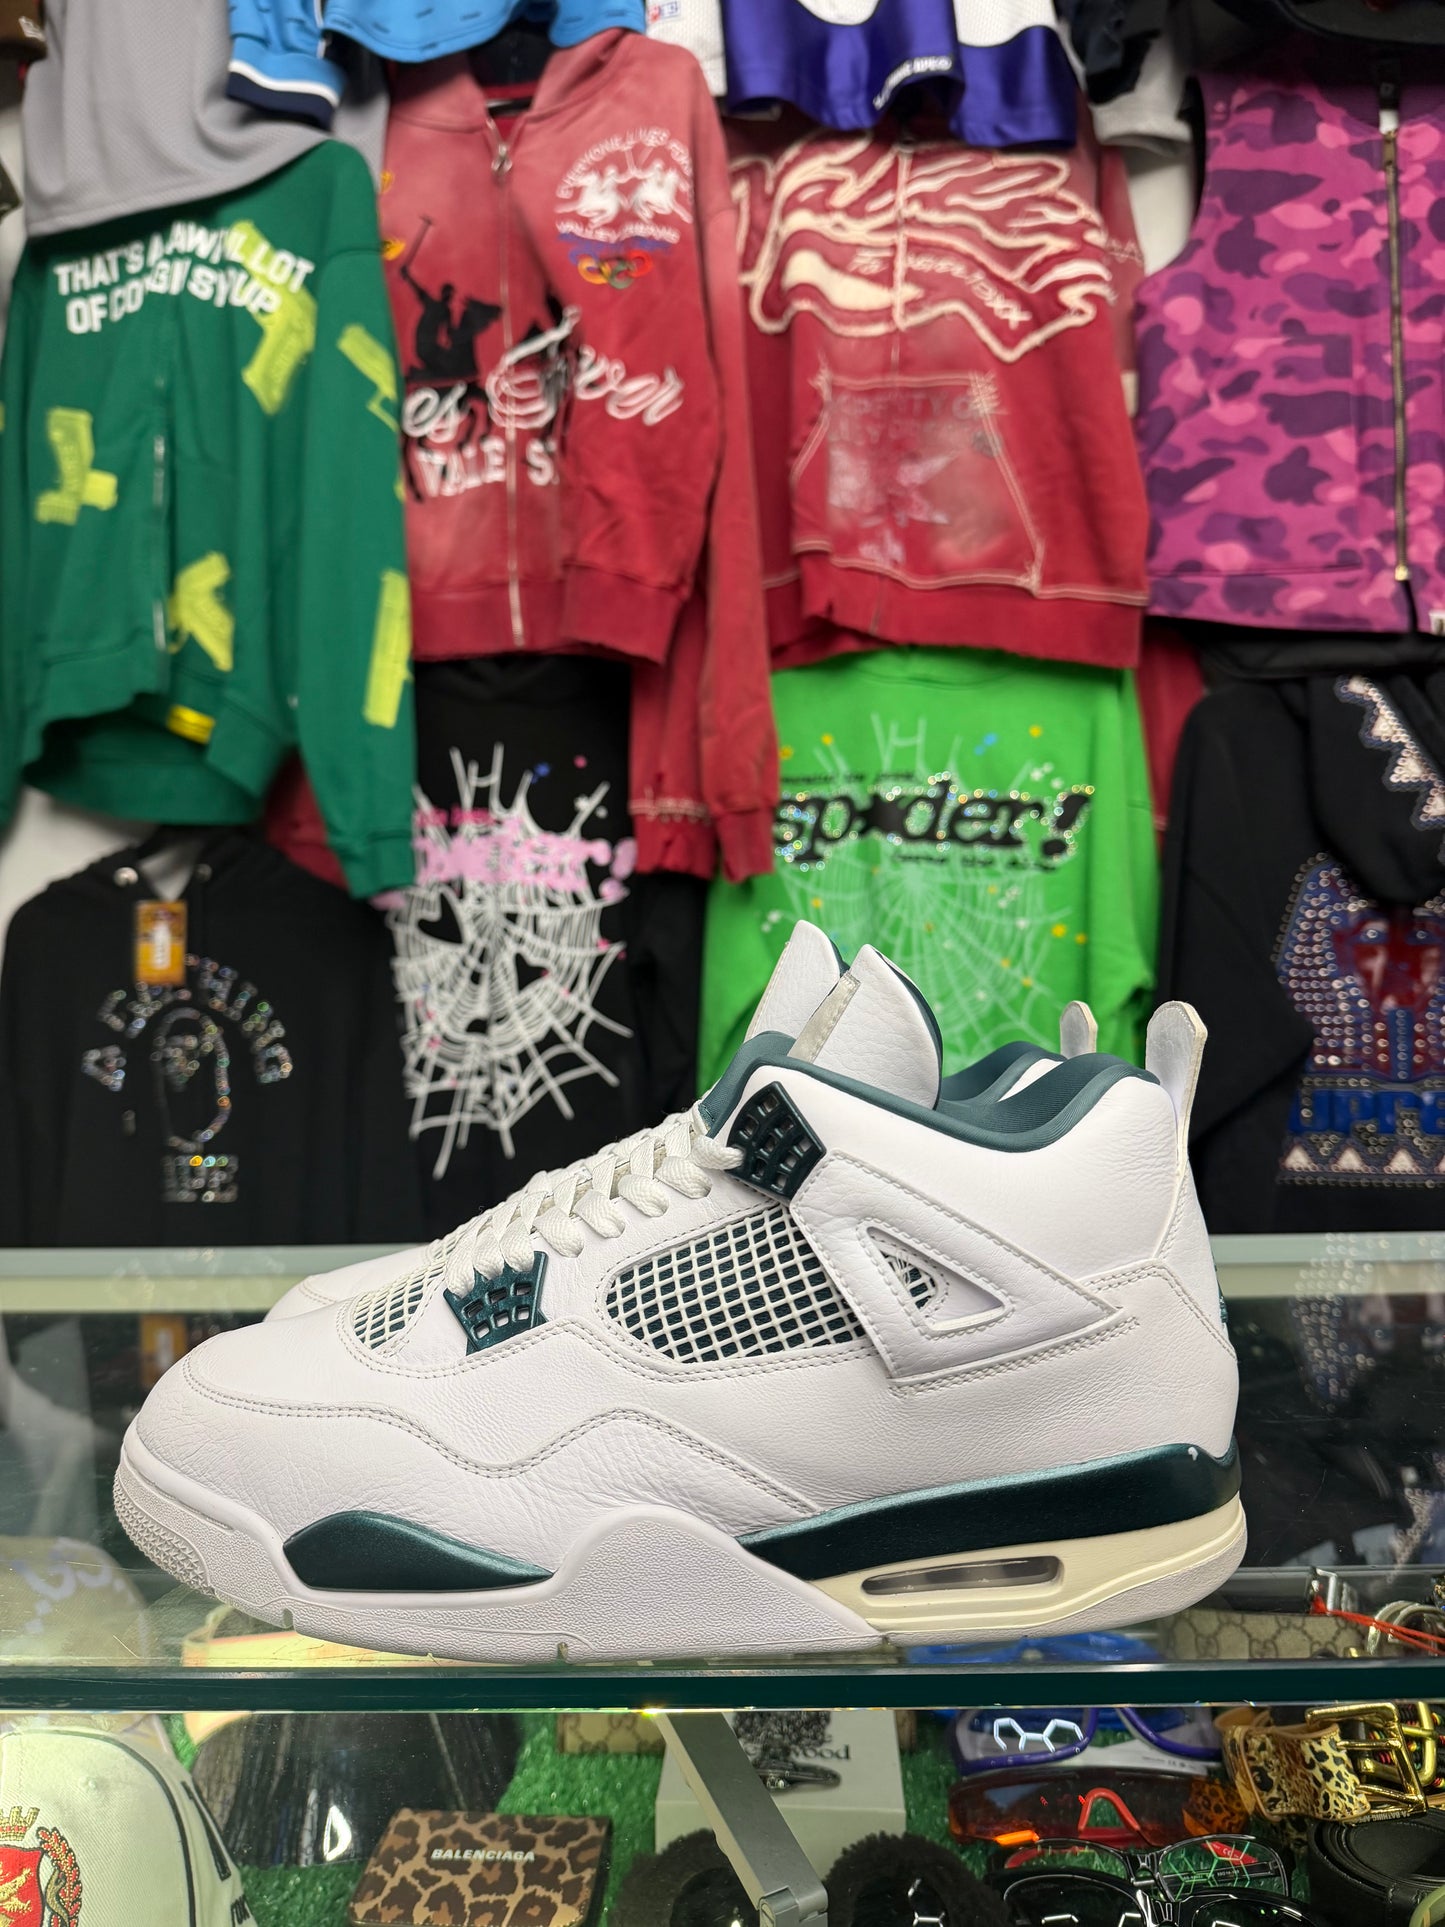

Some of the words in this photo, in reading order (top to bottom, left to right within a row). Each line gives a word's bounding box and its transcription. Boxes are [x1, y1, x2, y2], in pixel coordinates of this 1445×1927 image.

[53, 241, 145, 296] THAT'S
[247, 239, 315, 294] LOT
[66, 292, 108, 335] OF
[431, 1848, 535, 1862] BALENCIAGA
